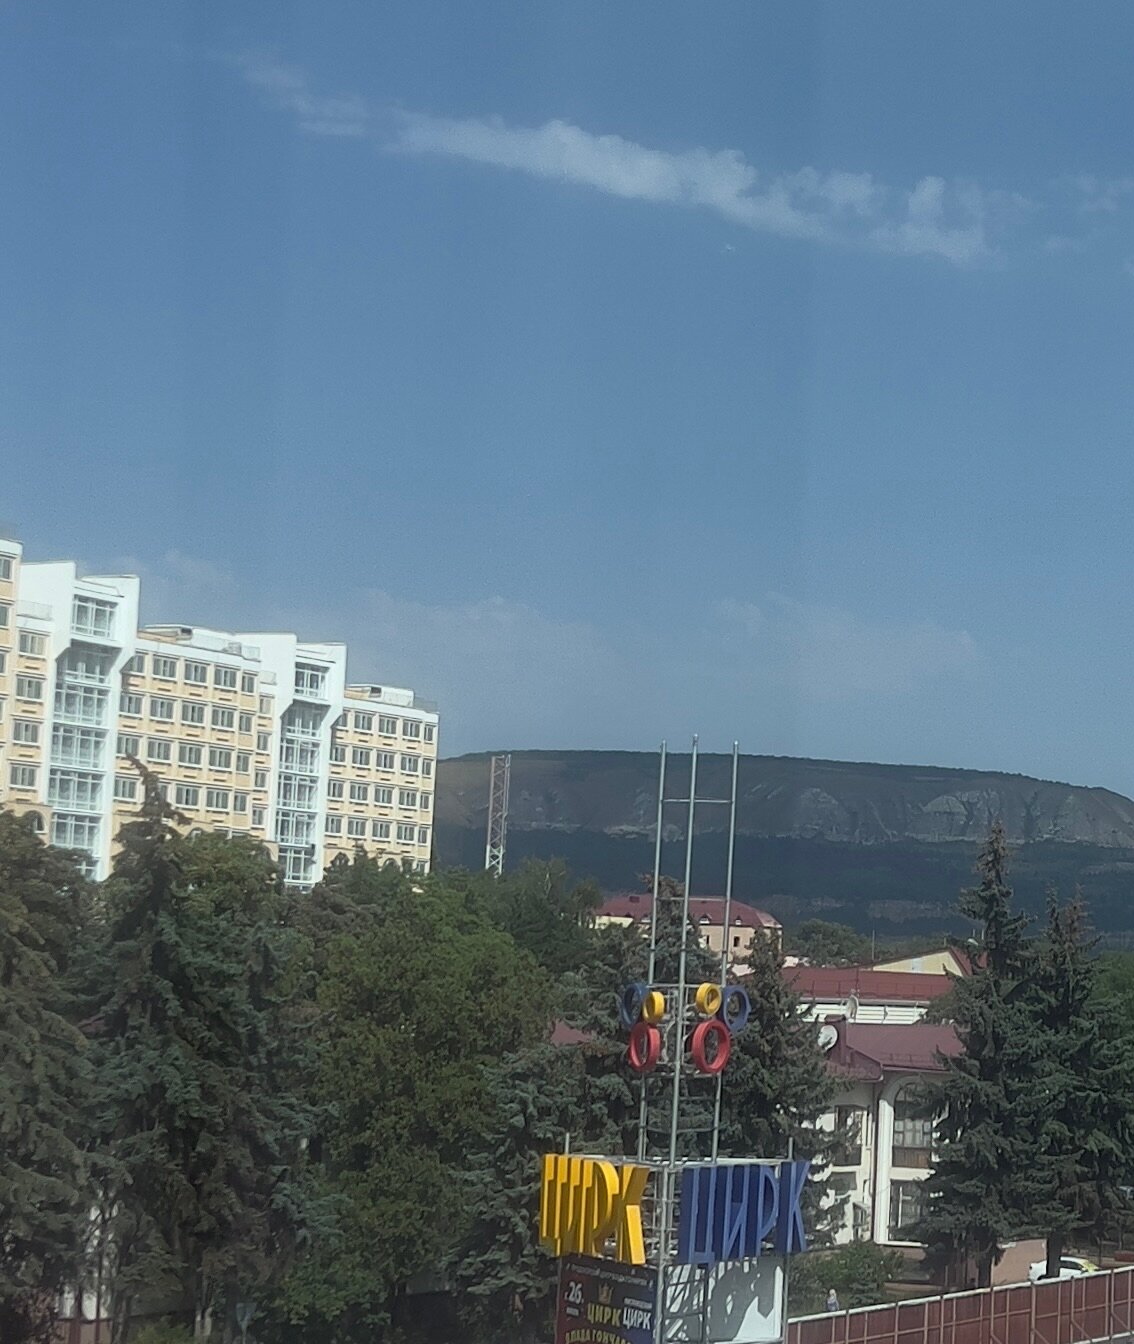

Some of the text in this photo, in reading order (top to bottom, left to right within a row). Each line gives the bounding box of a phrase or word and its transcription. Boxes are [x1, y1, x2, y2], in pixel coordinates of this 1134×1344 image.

[540, 1154, 650, 1265] ЦИРК
[677, 1160, 811, 1270] ЦИРК
[587, 1302, 621, 1327] ЦИРК
[622, 1307, 651, 1330] ЦИРК
